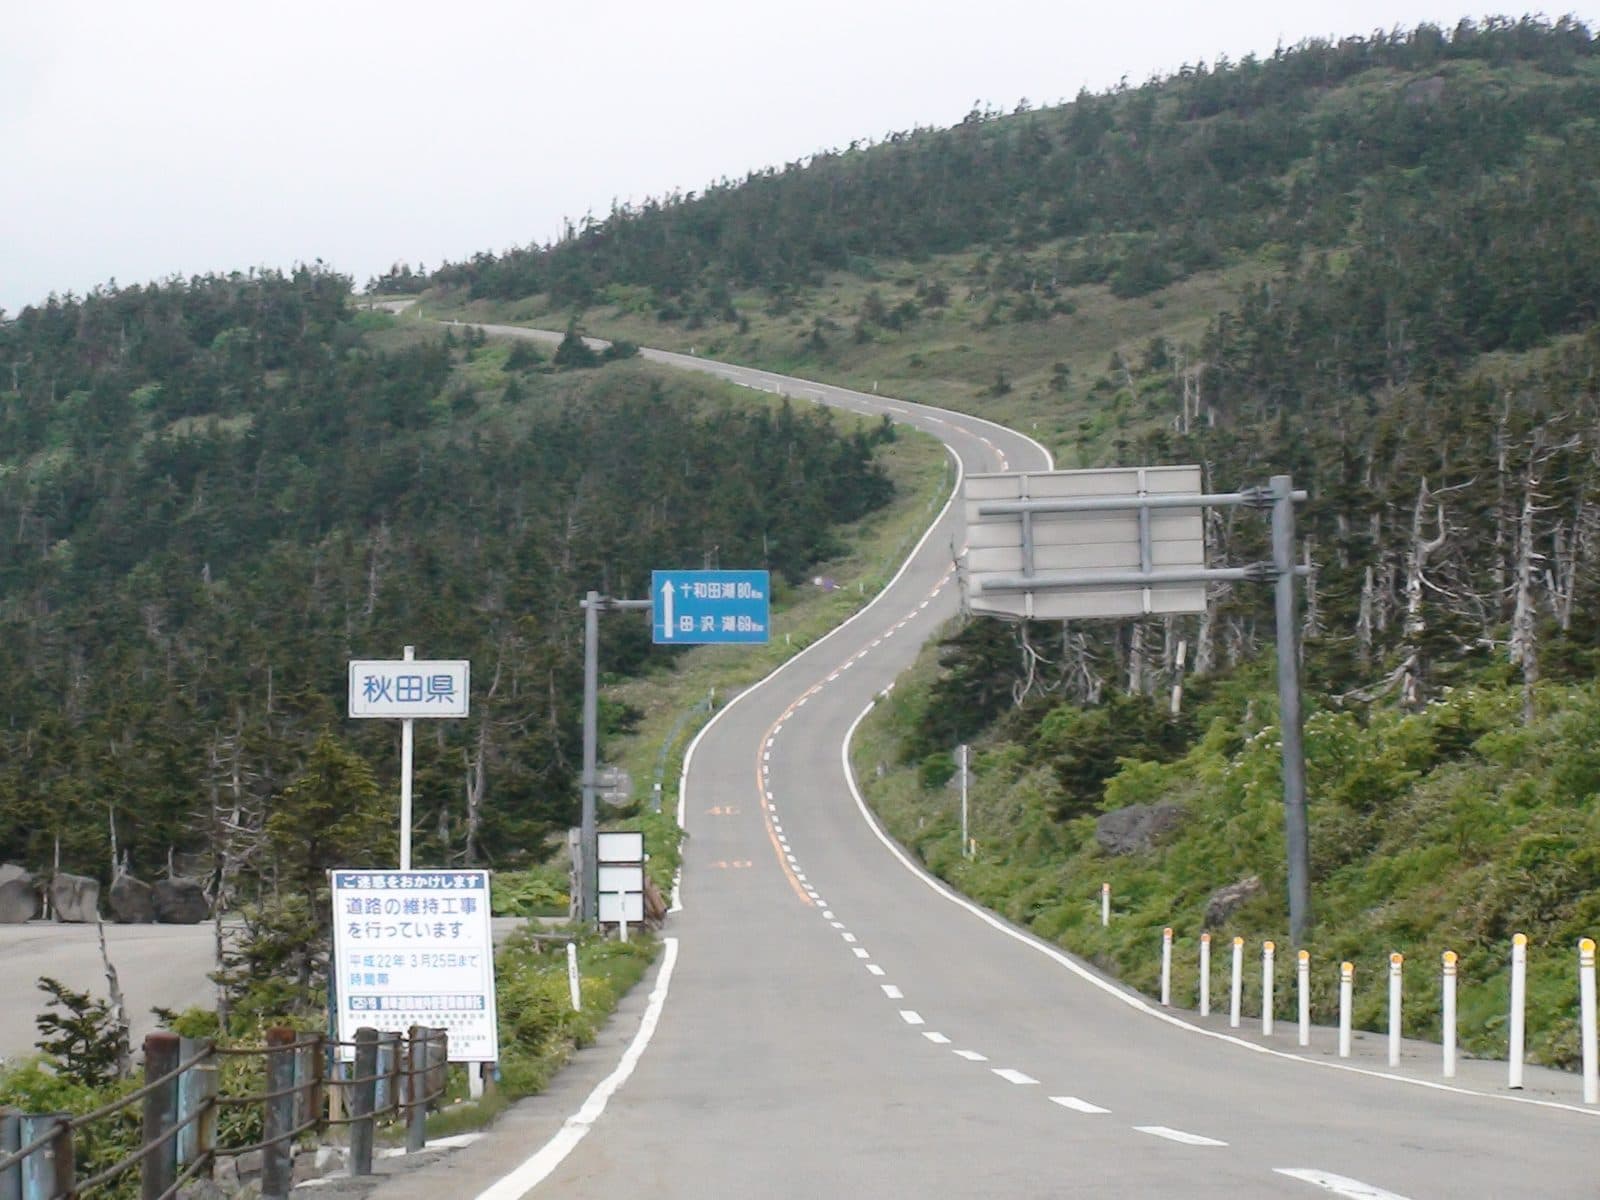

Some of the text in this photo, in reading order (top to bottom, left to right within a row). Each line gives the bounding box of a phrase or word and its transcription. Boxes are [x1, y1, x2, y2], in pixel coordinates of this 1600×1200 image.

[680, 582, 735, 599] 十和田湖
[680, 615, 735, 632] 田沢湖
[363, 675, 457, 703] 秋田県
[343, 875, 480, 889] ご迷惑をおかけします
[345, 896, 477, 915] 道路の維持工事
